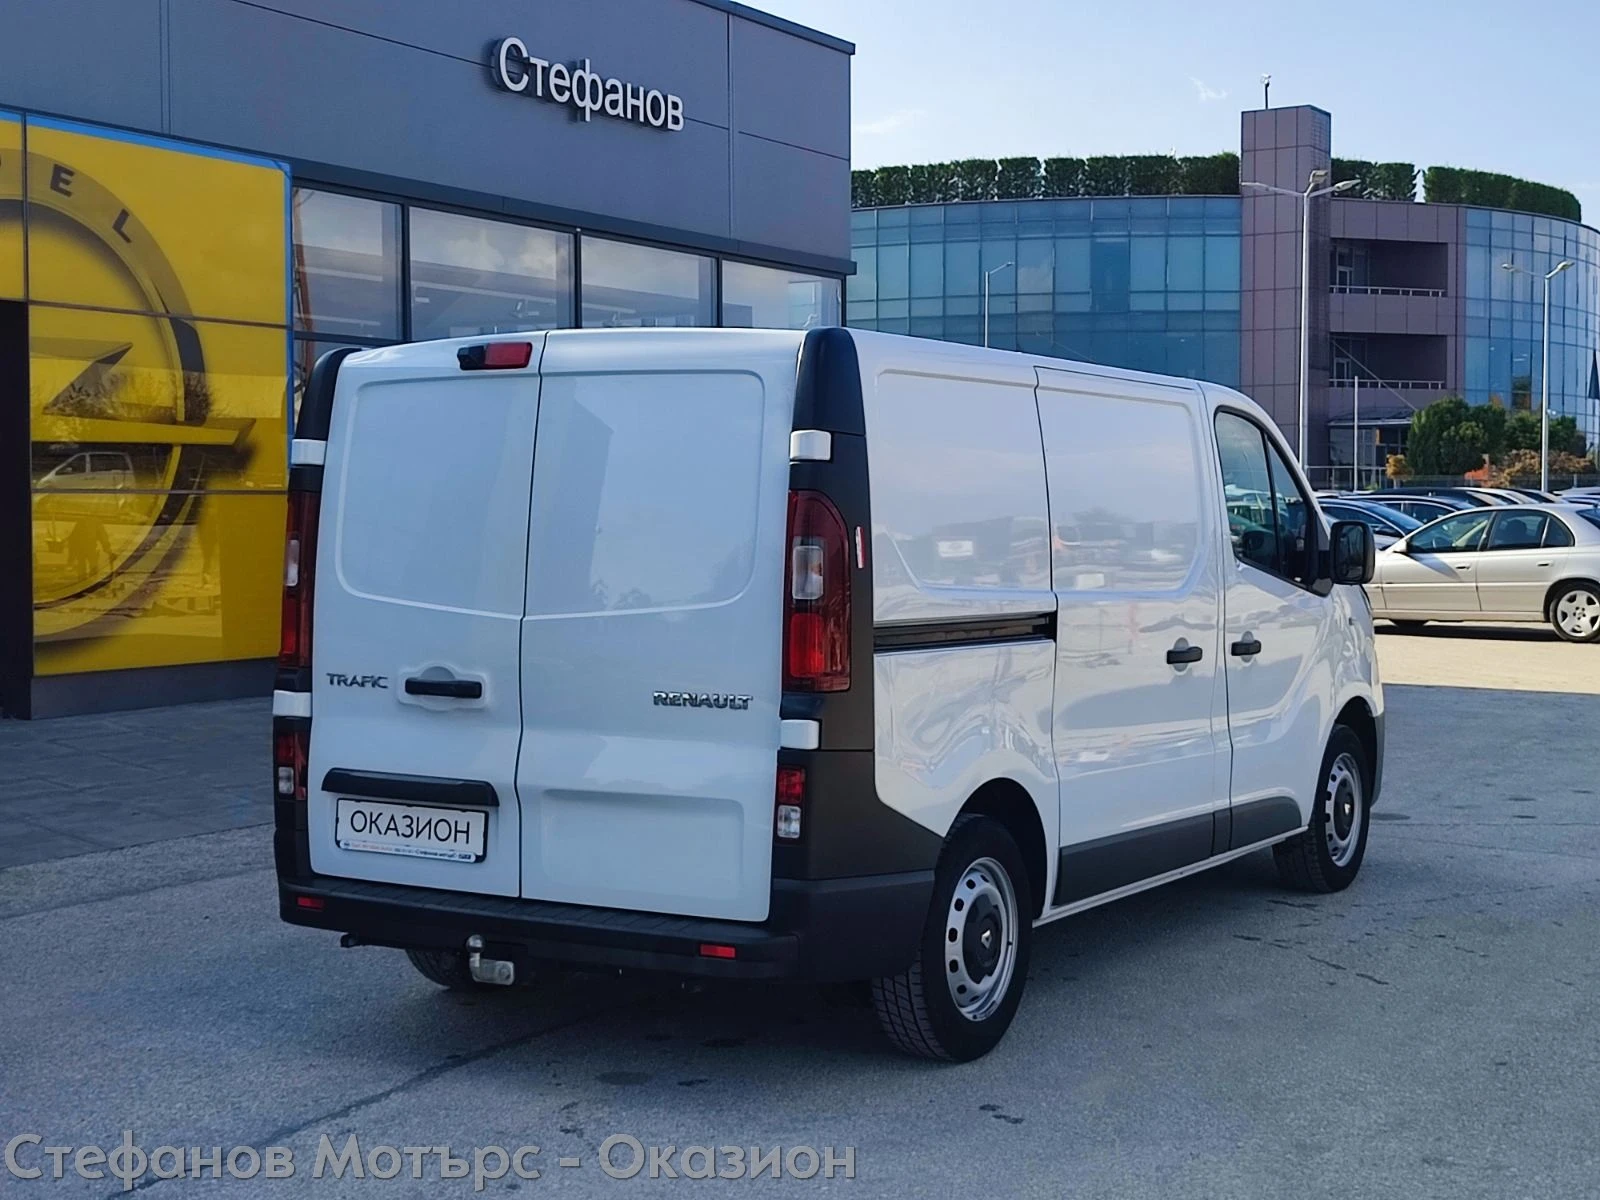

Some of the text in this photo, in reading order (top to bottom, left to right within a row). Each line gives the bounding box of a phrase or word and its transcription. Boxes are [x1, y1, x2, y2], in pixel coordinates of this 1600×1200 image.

[499, 36, 685, 132] Стефанов
[0, 156, 132, 244] EL
[326, 672, 389, 689] TRAFIC
[653, 690, 754, 710] RENAULT
[350, 810, 471, 844] ОКАЗИОН
